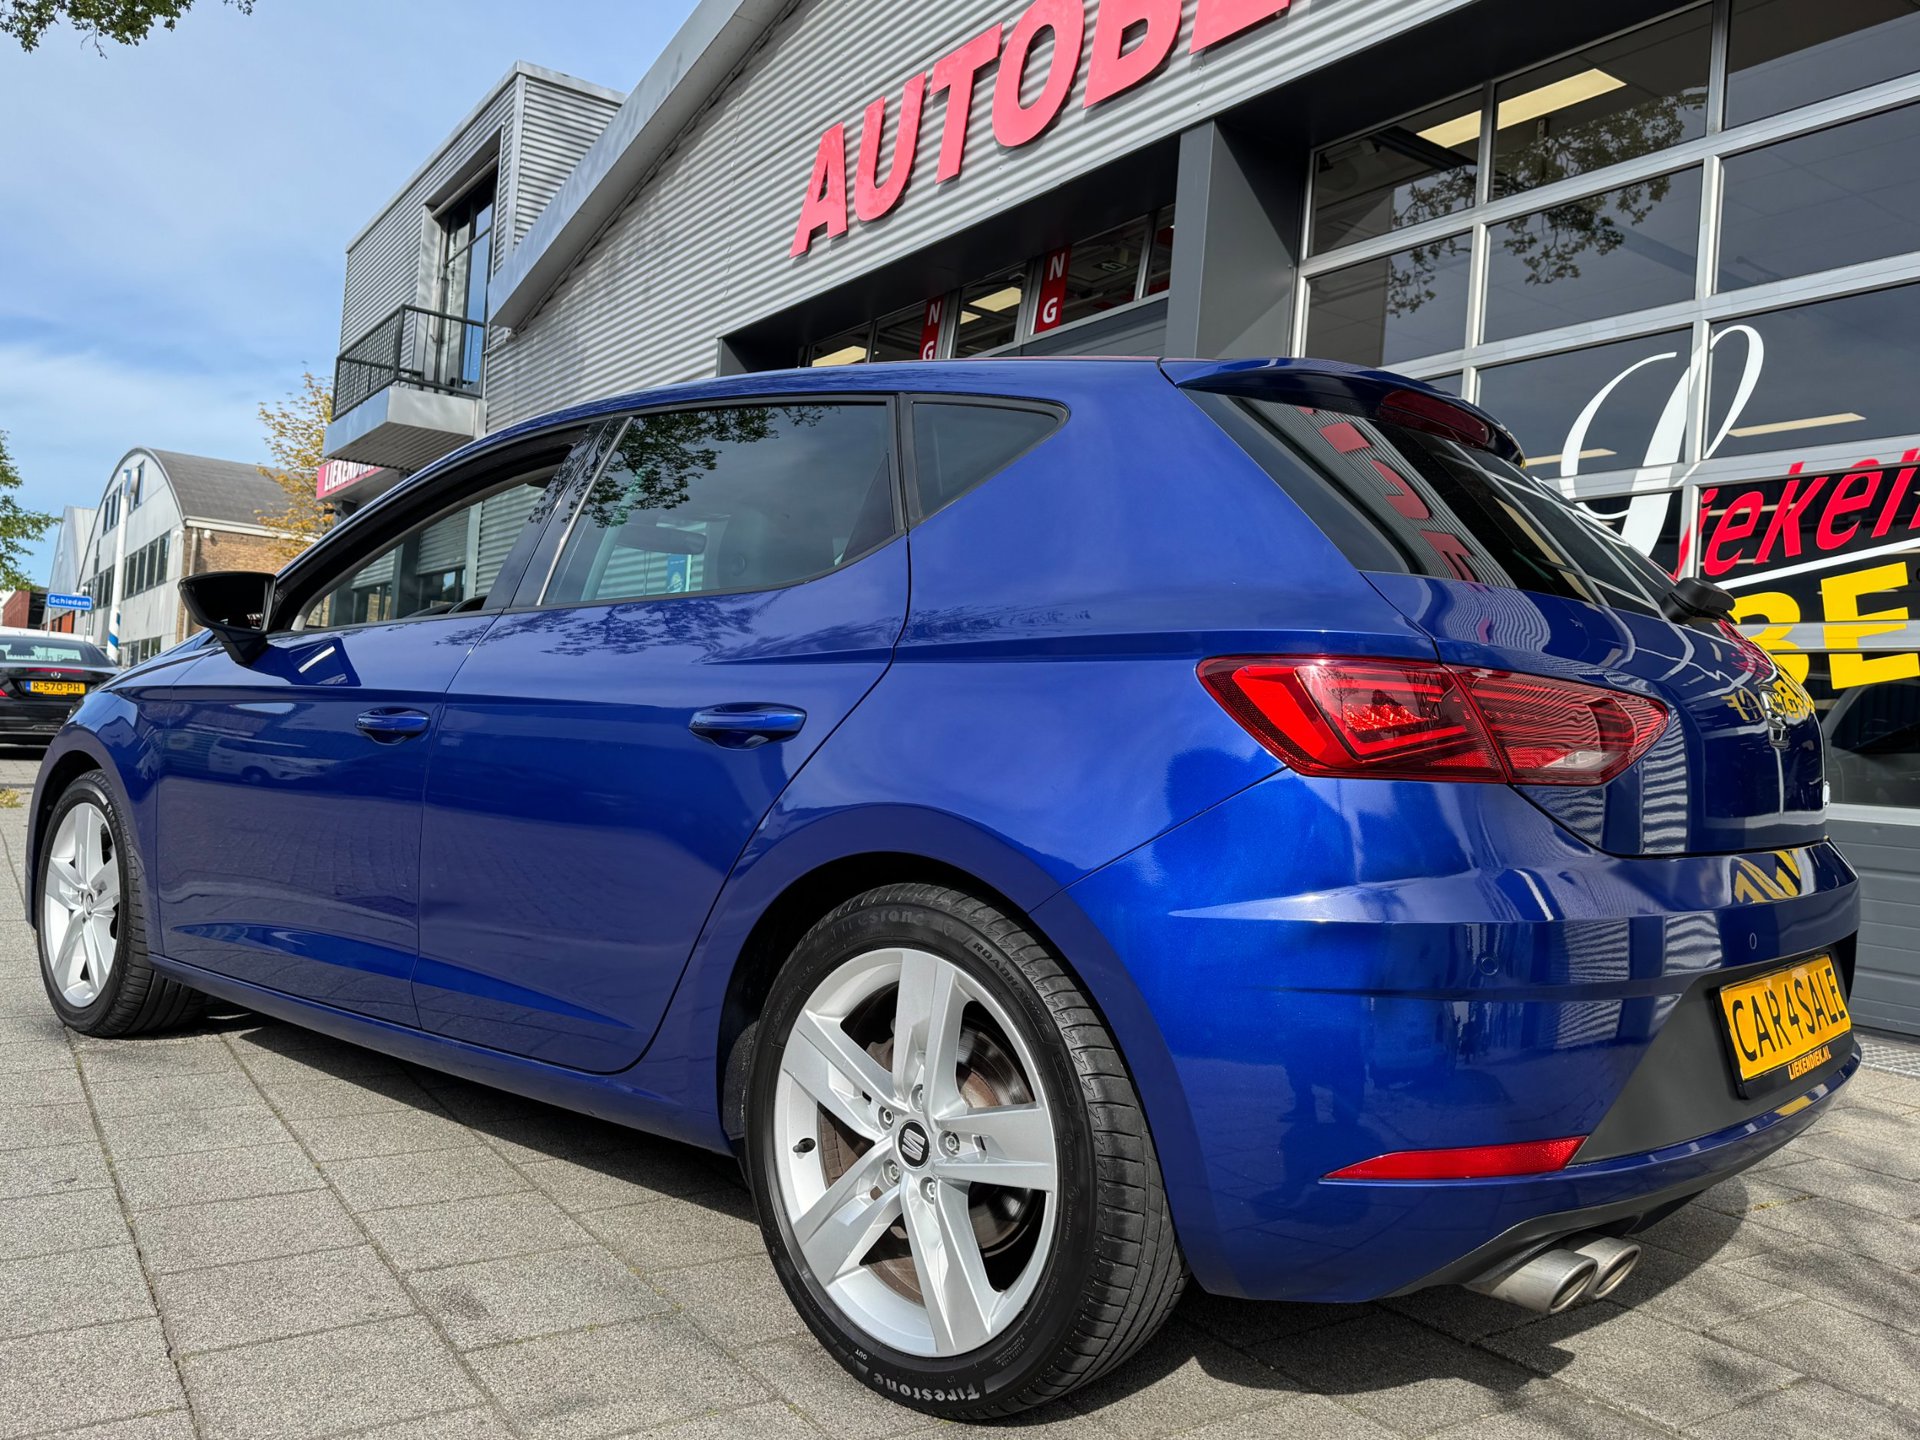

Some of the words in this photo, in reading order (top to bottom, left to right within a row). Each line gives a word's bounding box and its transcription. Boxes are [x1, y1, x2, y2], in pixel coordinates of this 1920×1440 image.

[789, 0, 1289, 257] AUTOB
[50, 596, 90, 607] Schiedam
[33, 682, 80, 691] R-570-PH
[855, 1348, 868, 1361] OUT
[873, 1372, 981, 1402] Firestone
